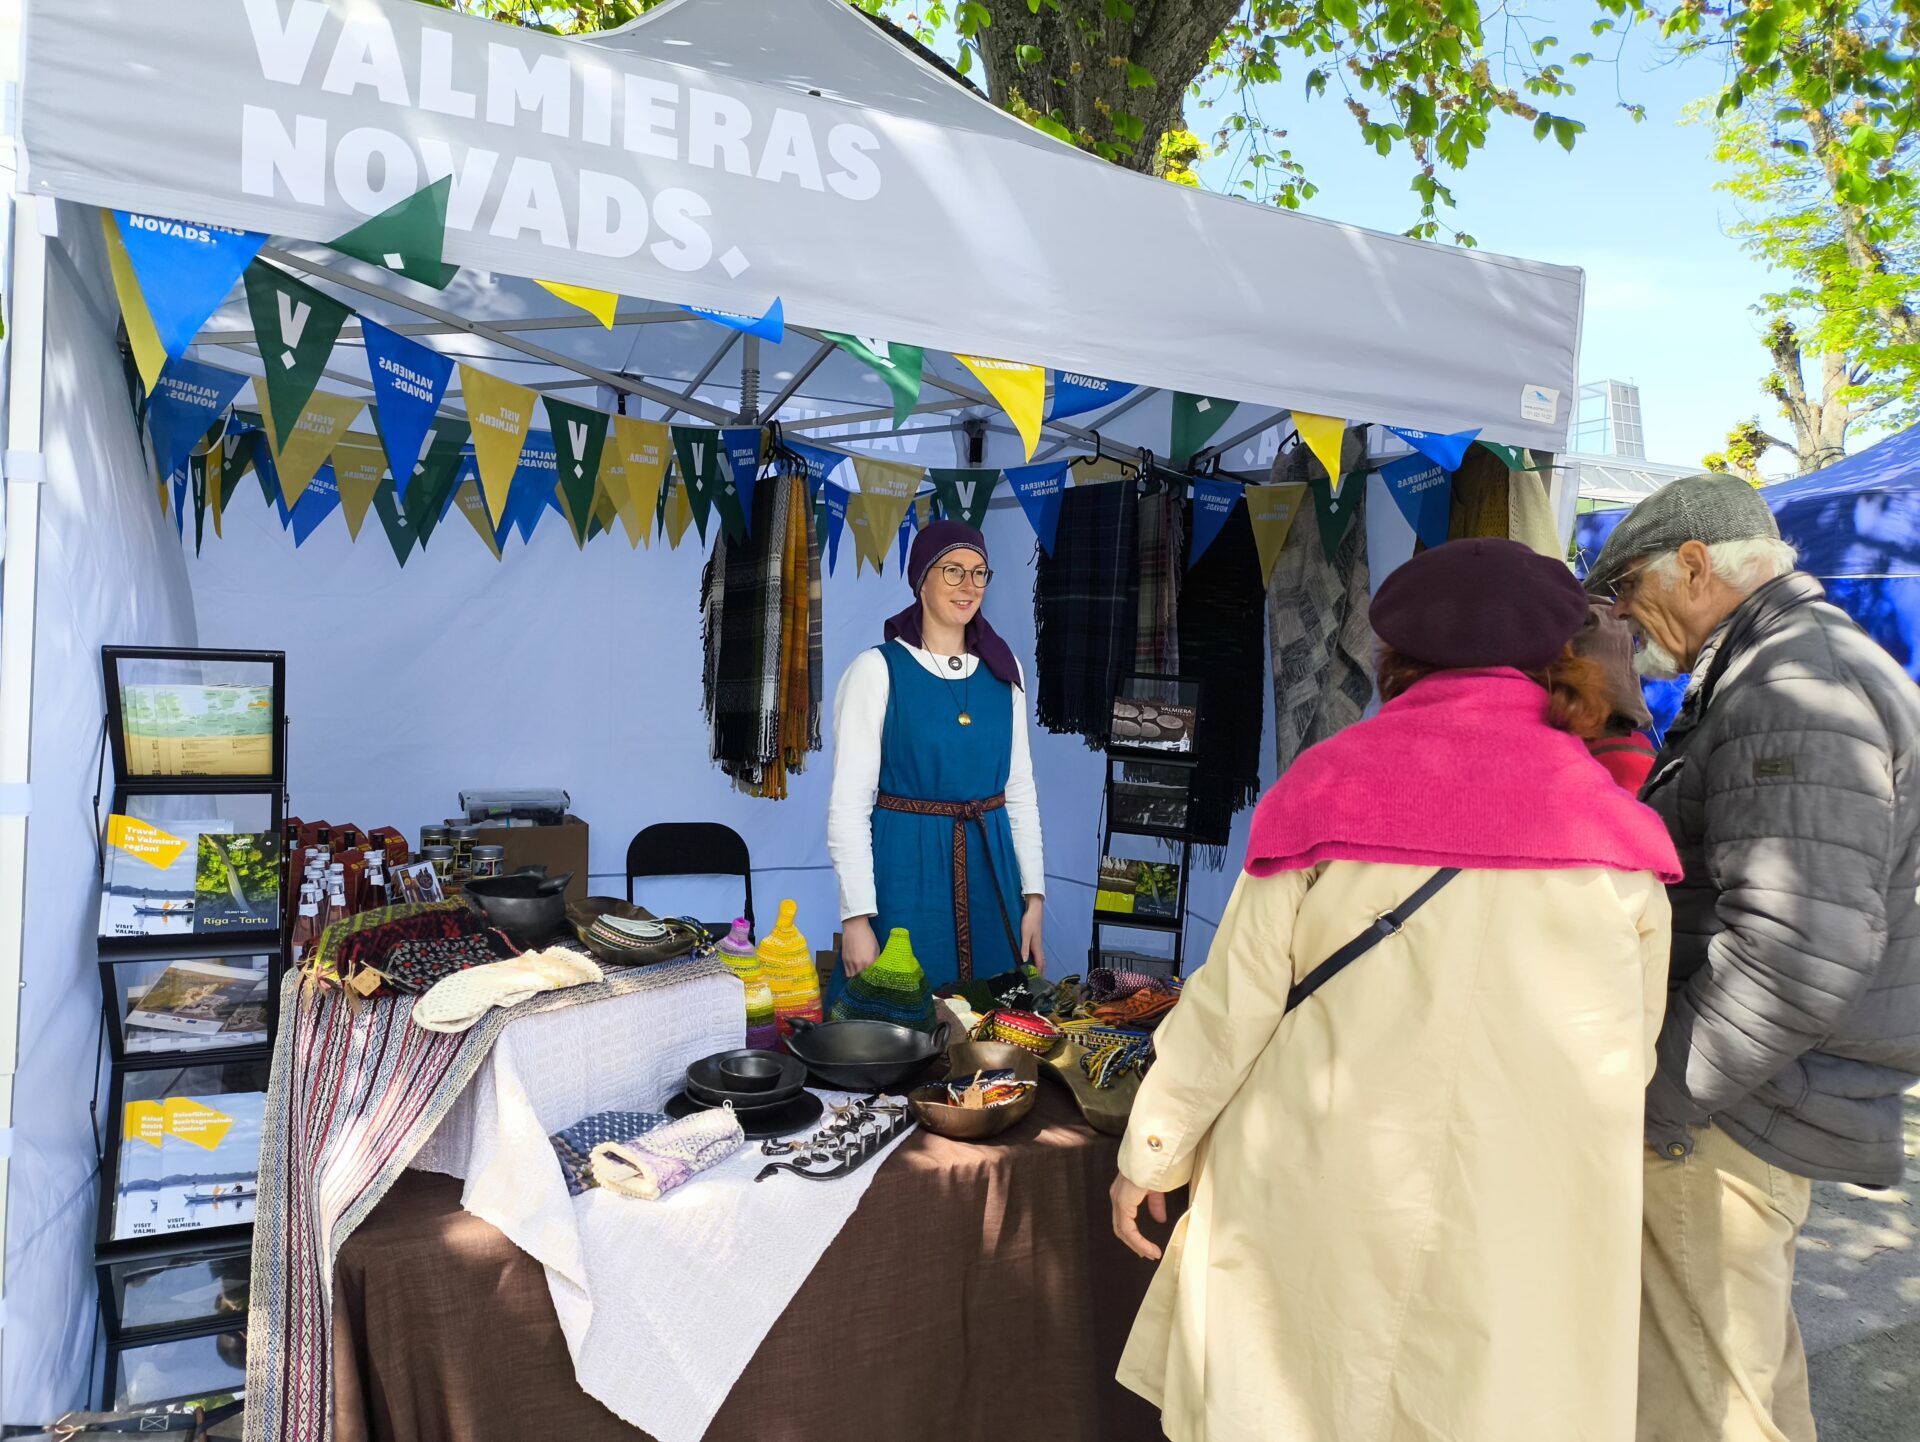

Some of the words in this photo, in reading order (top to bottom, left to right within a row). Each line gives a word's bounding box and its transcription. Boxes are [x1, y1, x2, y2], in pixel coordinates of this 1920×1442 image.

[244, 0, 881, 200] VALMIERAS
[241, 104, 750, 279] NOVADS.
[129, 214, 217, 244] NOVADS.
[1062, 372, 1109, 391] NOVADS.
[126, 825, 158, 836] Travel
[137, 836, 182, 847] Valmiera
[239, 916, 269, 925] Tartu
